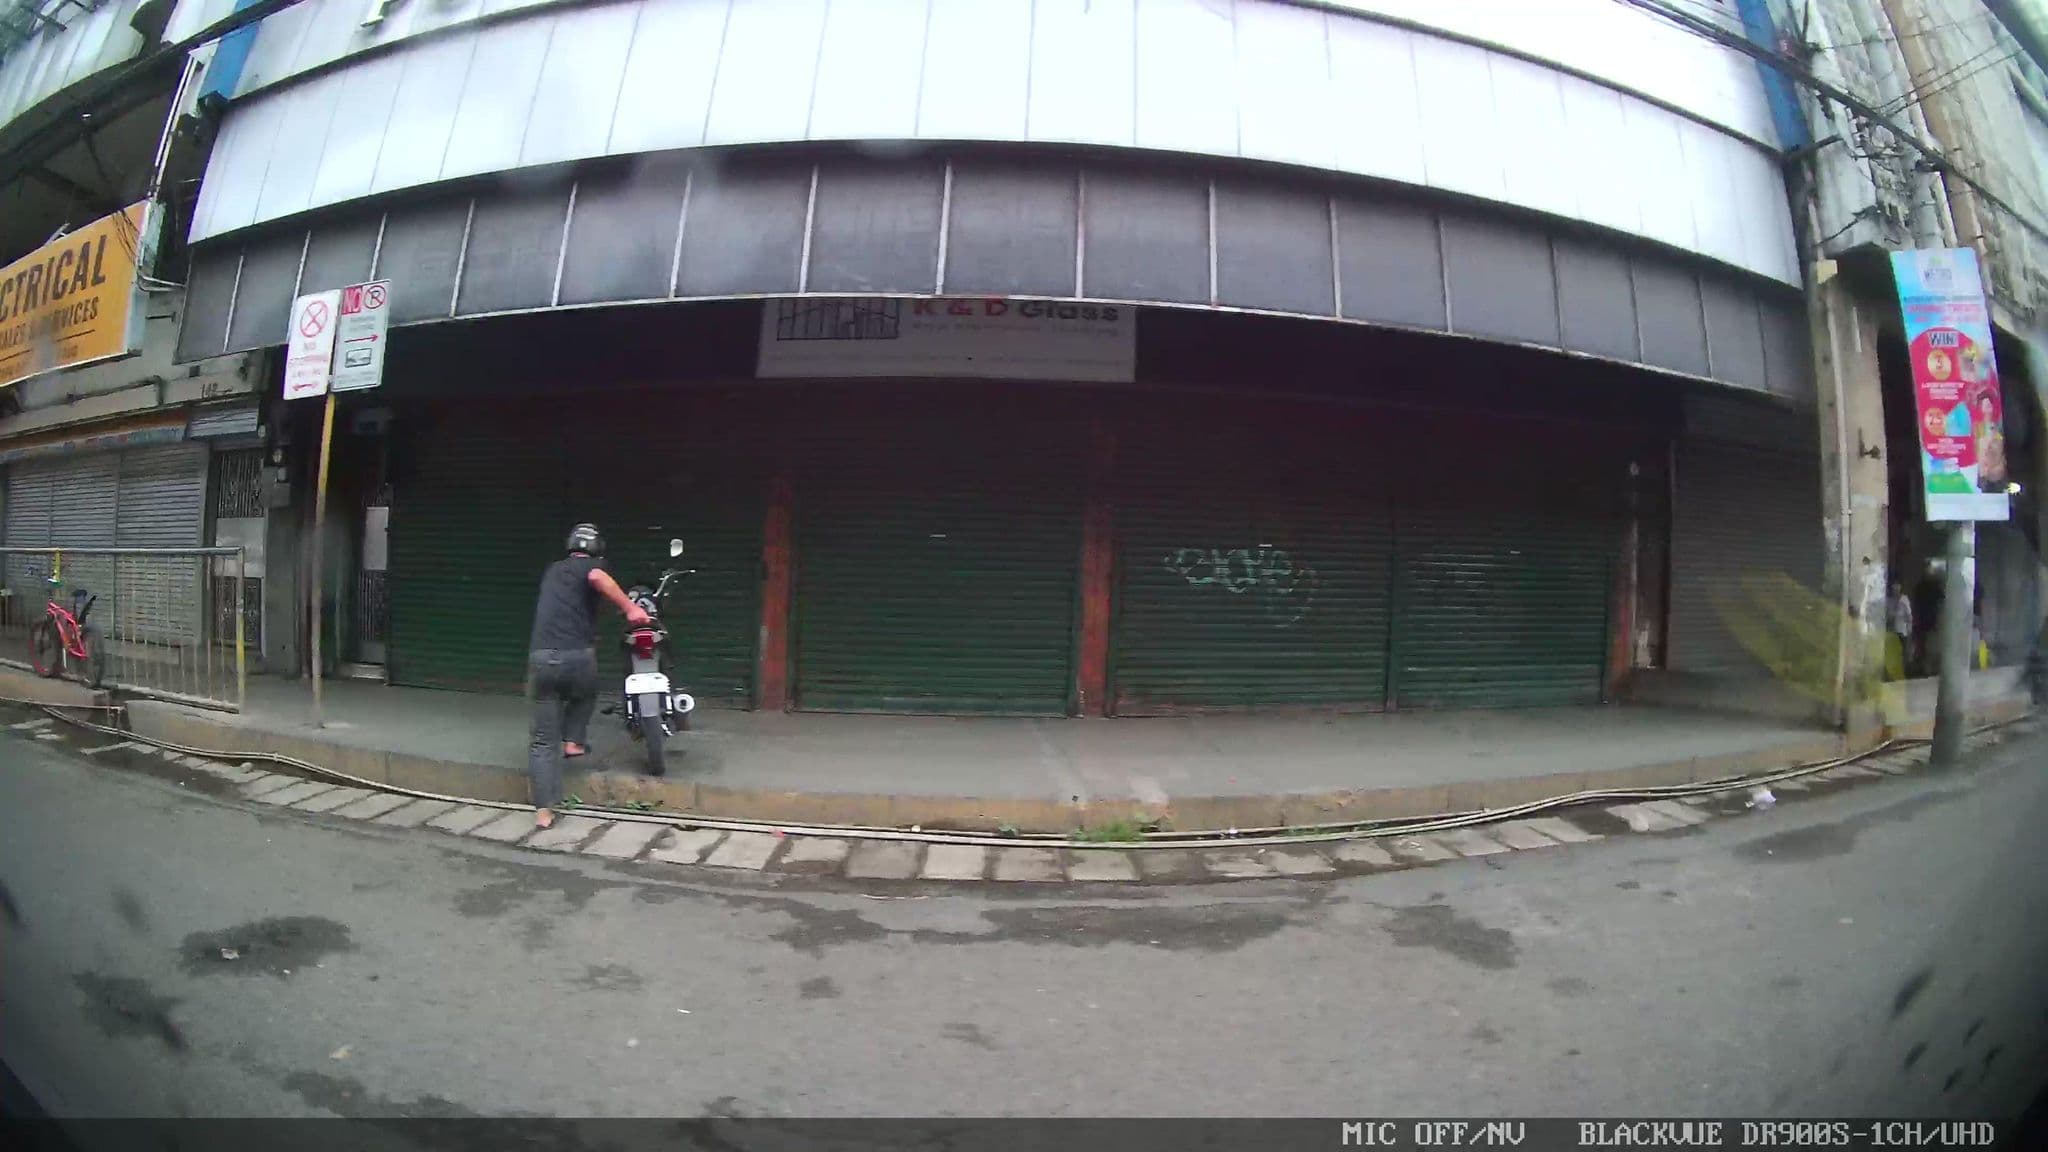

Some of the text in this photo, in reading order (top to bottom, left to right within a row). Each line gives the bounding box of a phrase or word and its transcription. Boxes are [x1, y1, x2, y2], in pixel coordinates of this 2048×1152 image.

[343, 286, 361, 314] NO
[947, 301, 973, 316] &
[986, 299, 1009, 316] D
[1018, 300, 1120, 321] Glass
[1929, 332, 1957, 346] WIN
